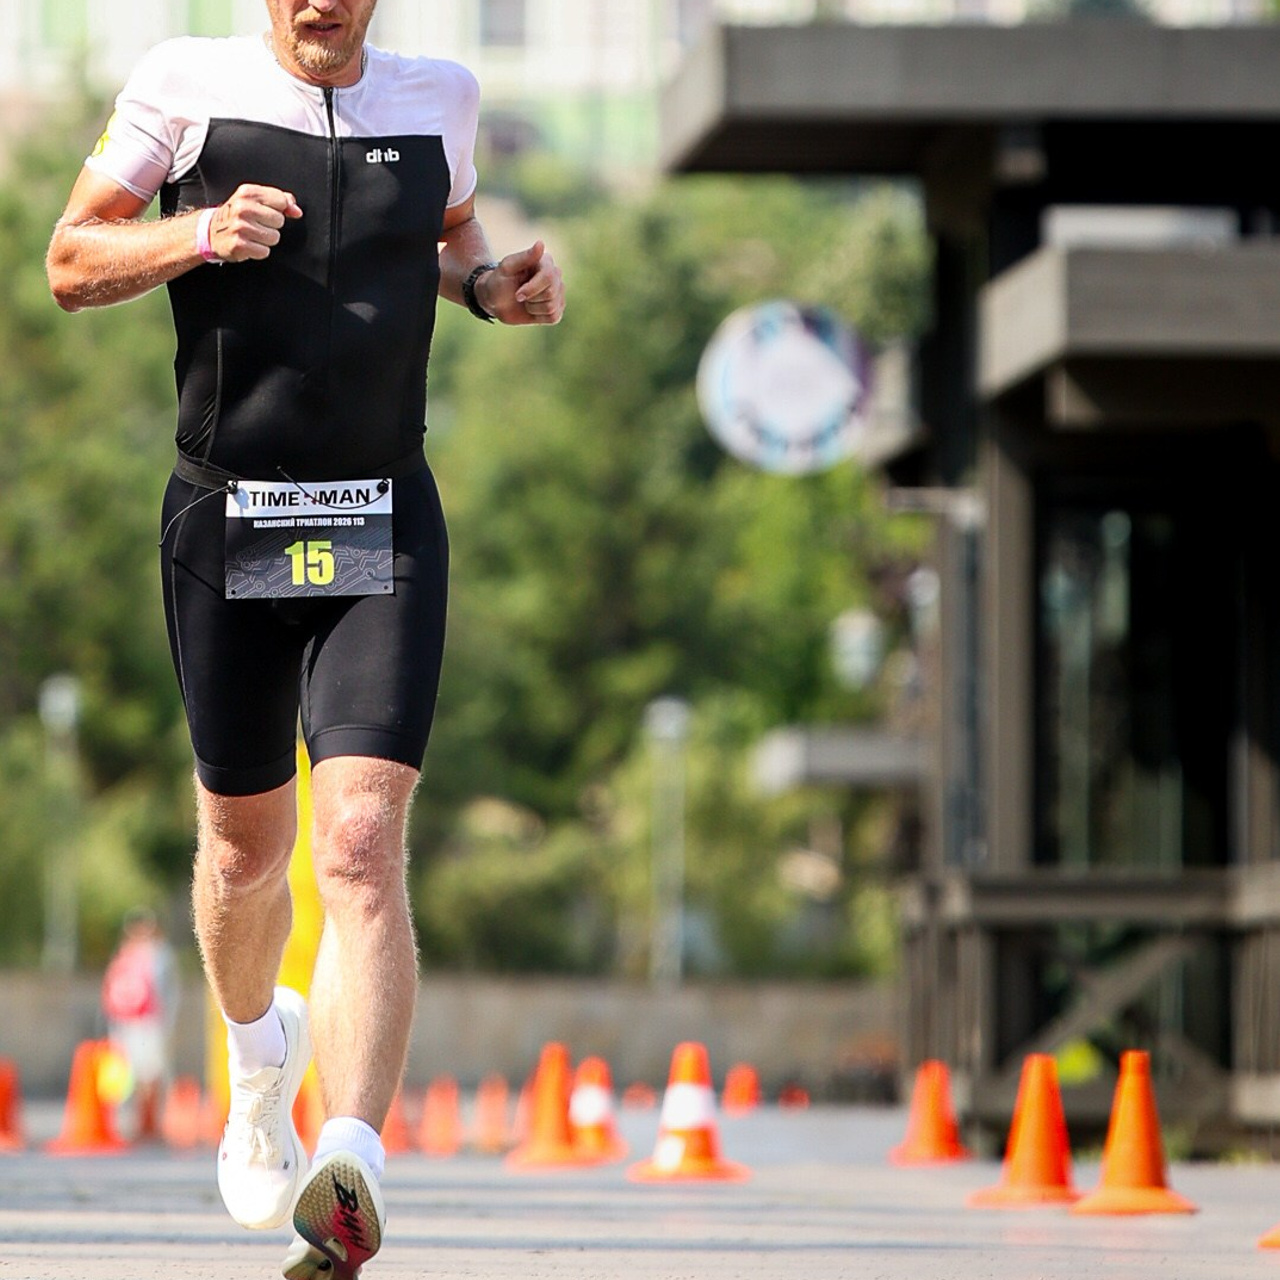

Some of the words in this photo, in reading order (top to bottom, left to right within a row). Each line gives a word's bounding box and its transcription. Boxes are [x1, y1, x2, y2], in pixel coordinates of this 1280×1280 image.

[366, 147, 400, 163] dhb
[296, 517, 332, 527] ТРИАТЛОН
[284, 540, 335, 585] 15
